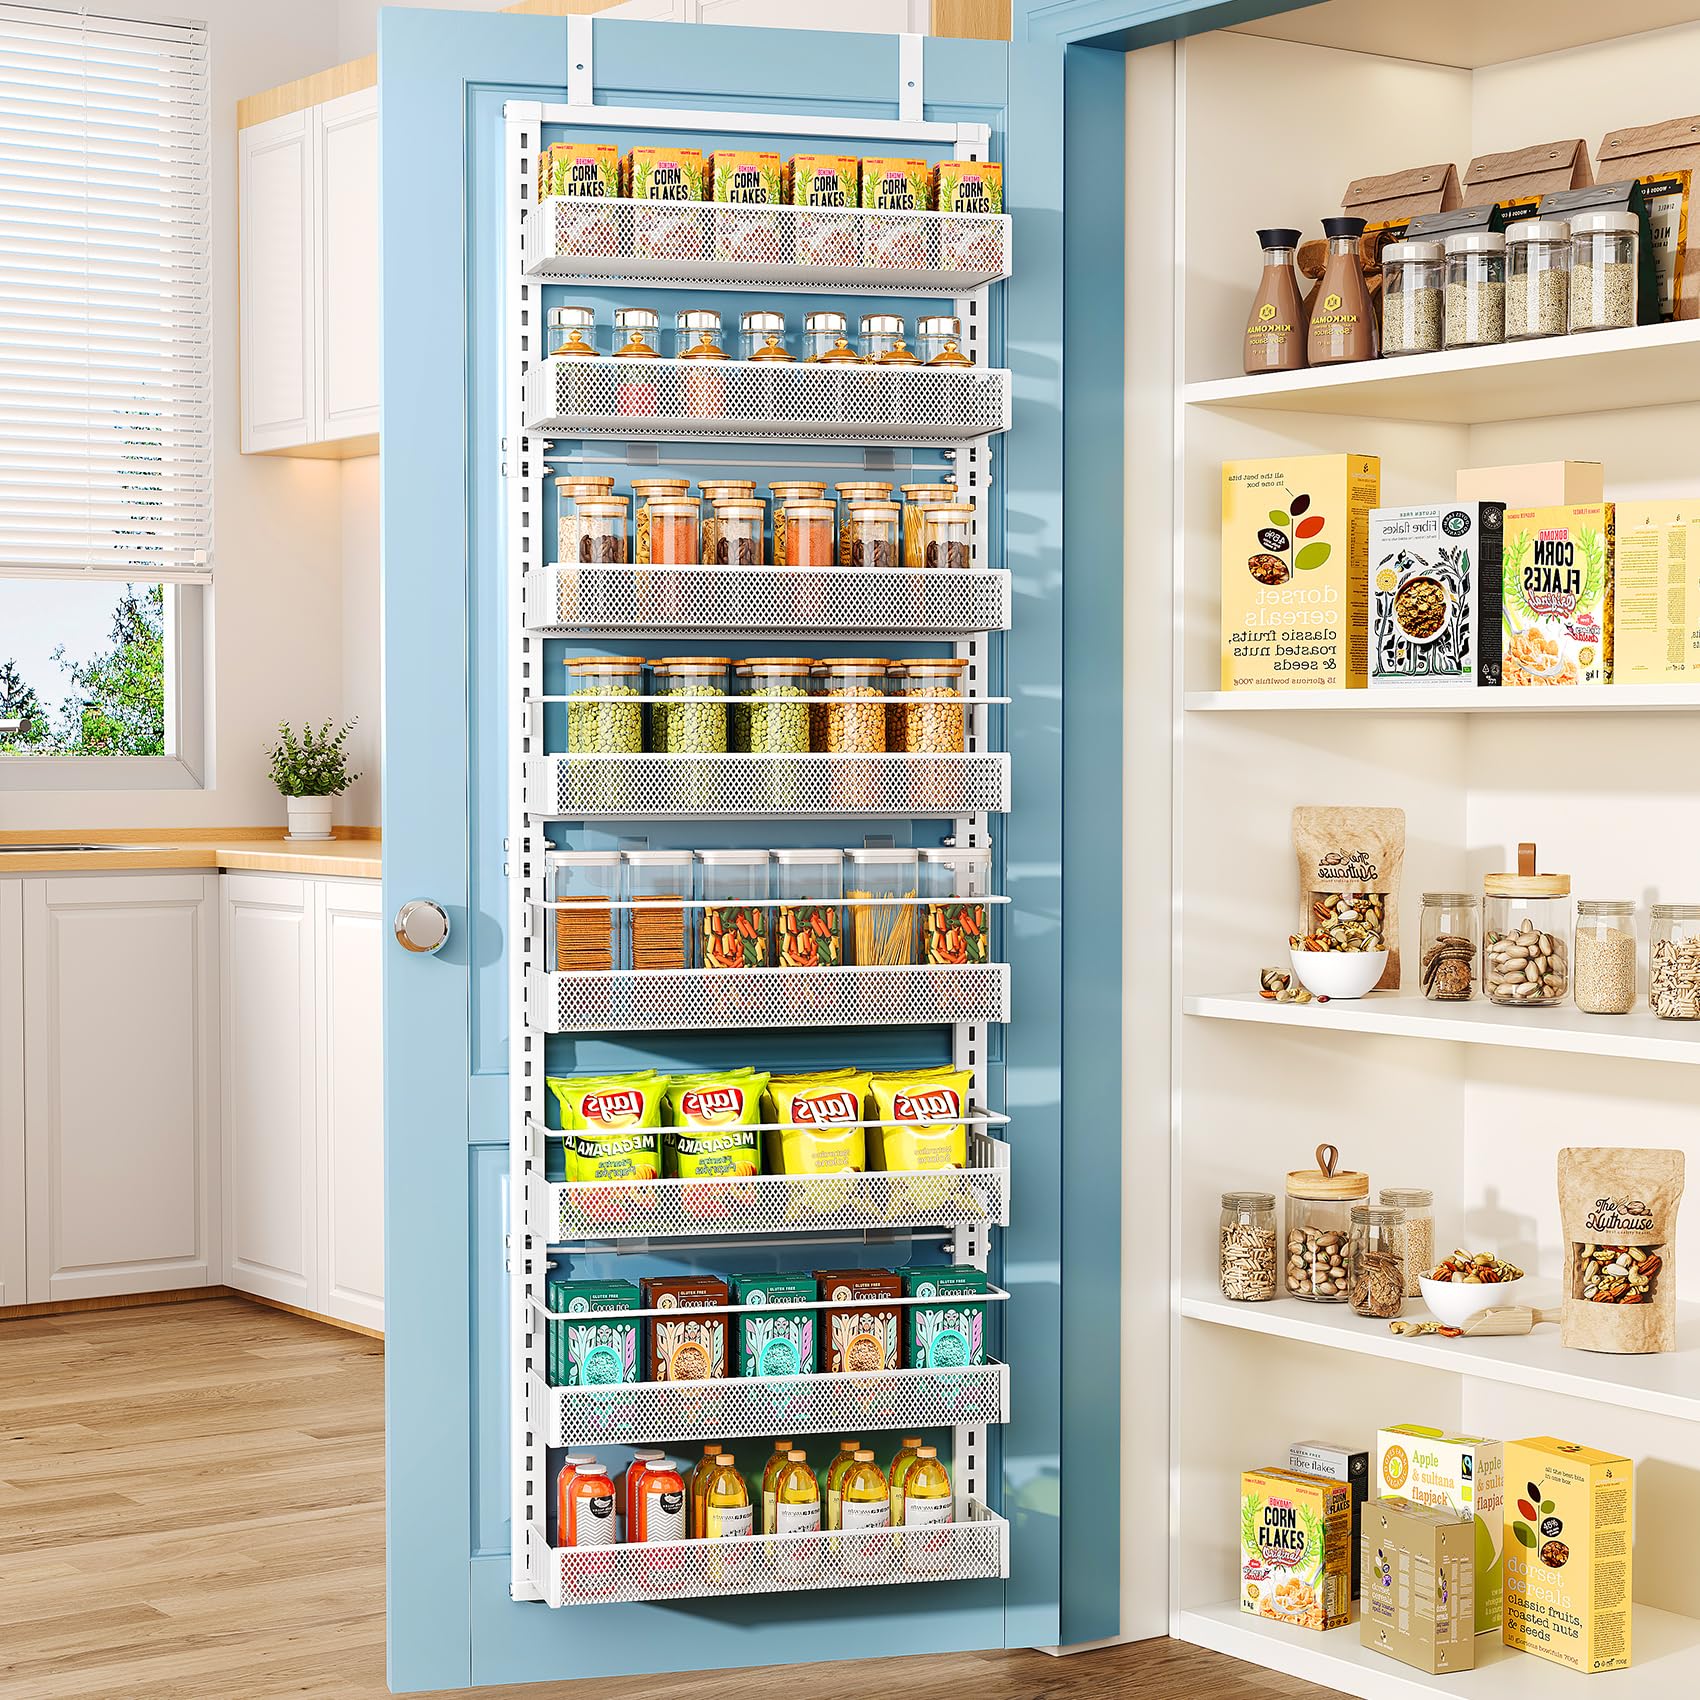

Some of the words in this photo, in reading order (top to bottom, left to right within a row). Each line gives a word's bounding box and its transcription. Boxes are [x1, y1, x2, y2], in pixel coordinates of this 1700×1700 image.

[572, 165, 598, 181] CORN
[654, 168, 681, 185] CORN
[734, 172, 760, 188] CORN
[568, 181, 604, 197] FLAKES
[650, 184, 688, 200] FLAKES
[814, 176, 838, 192] CORN
[882, 178, 907, 195] CORN
[959, 182, 984, 198] CORN
[730, 188, 766, 204] FLAKES
[810, 192, 844, 206] FLAKES
[878, 194, 914, 210] FLAKES
[956, 198, 989, 213] FLAKES
[1595, 1197, 1617, 1213] The
[1586, 1212, 1654, 1232] Nuthouse
[880, 1290, 892, 1298] rice
[963, 1286, 976, 1295] rice
[616, 1302, 630, 1311] rice
[705, 1298, 718, 1307] rice
[793, 1294, 806, 1304] rice
[1290, 1456, 1310, 1468] Fibre
[1311, 1461, 1336, 1474] flakes
[1412, 1450, 1438, 1468] Apple
[1477, 1456, 1502, 1476] Apple
[1412, 1469, 1419, 1482] &
[1422, 1472, 1455, 1489] sultana
[1562, 1470, 1572, 1478] best
[1477, 1478, 1484, 1492] &
[1332, 1492, 1347, 1505] CORN
[1412, 1486, 1448, 1506] flapjack
[1477, 1494, 1504, 1512] flapjac
[1330, 1500, 1350, 1514] FLAKES
[1264, 1506, 1296, 1528] CORN
[1259, 1527, 1304, 1550] FLAKES
[1508, 1556, 1564, 1588] dorset
[1508, 1576, 1572, 1608] cereals
[1248, 1601, 1254, 1610] kg
[1508, 1593, 1546, 1614] classic
[1548, 1604, 1583, 1630] fruits,
[1508, 1606, 1550, 1629] roasted
[1552, 1621, 1579, 1639] nuts
[1508, 1618, 1518, 1630] &
[1520, 1624, 1550, 1642] seeds
[1516, 1636, 1538, 1650] glorious
[1564, 1653, 1578, 1665] 700g
